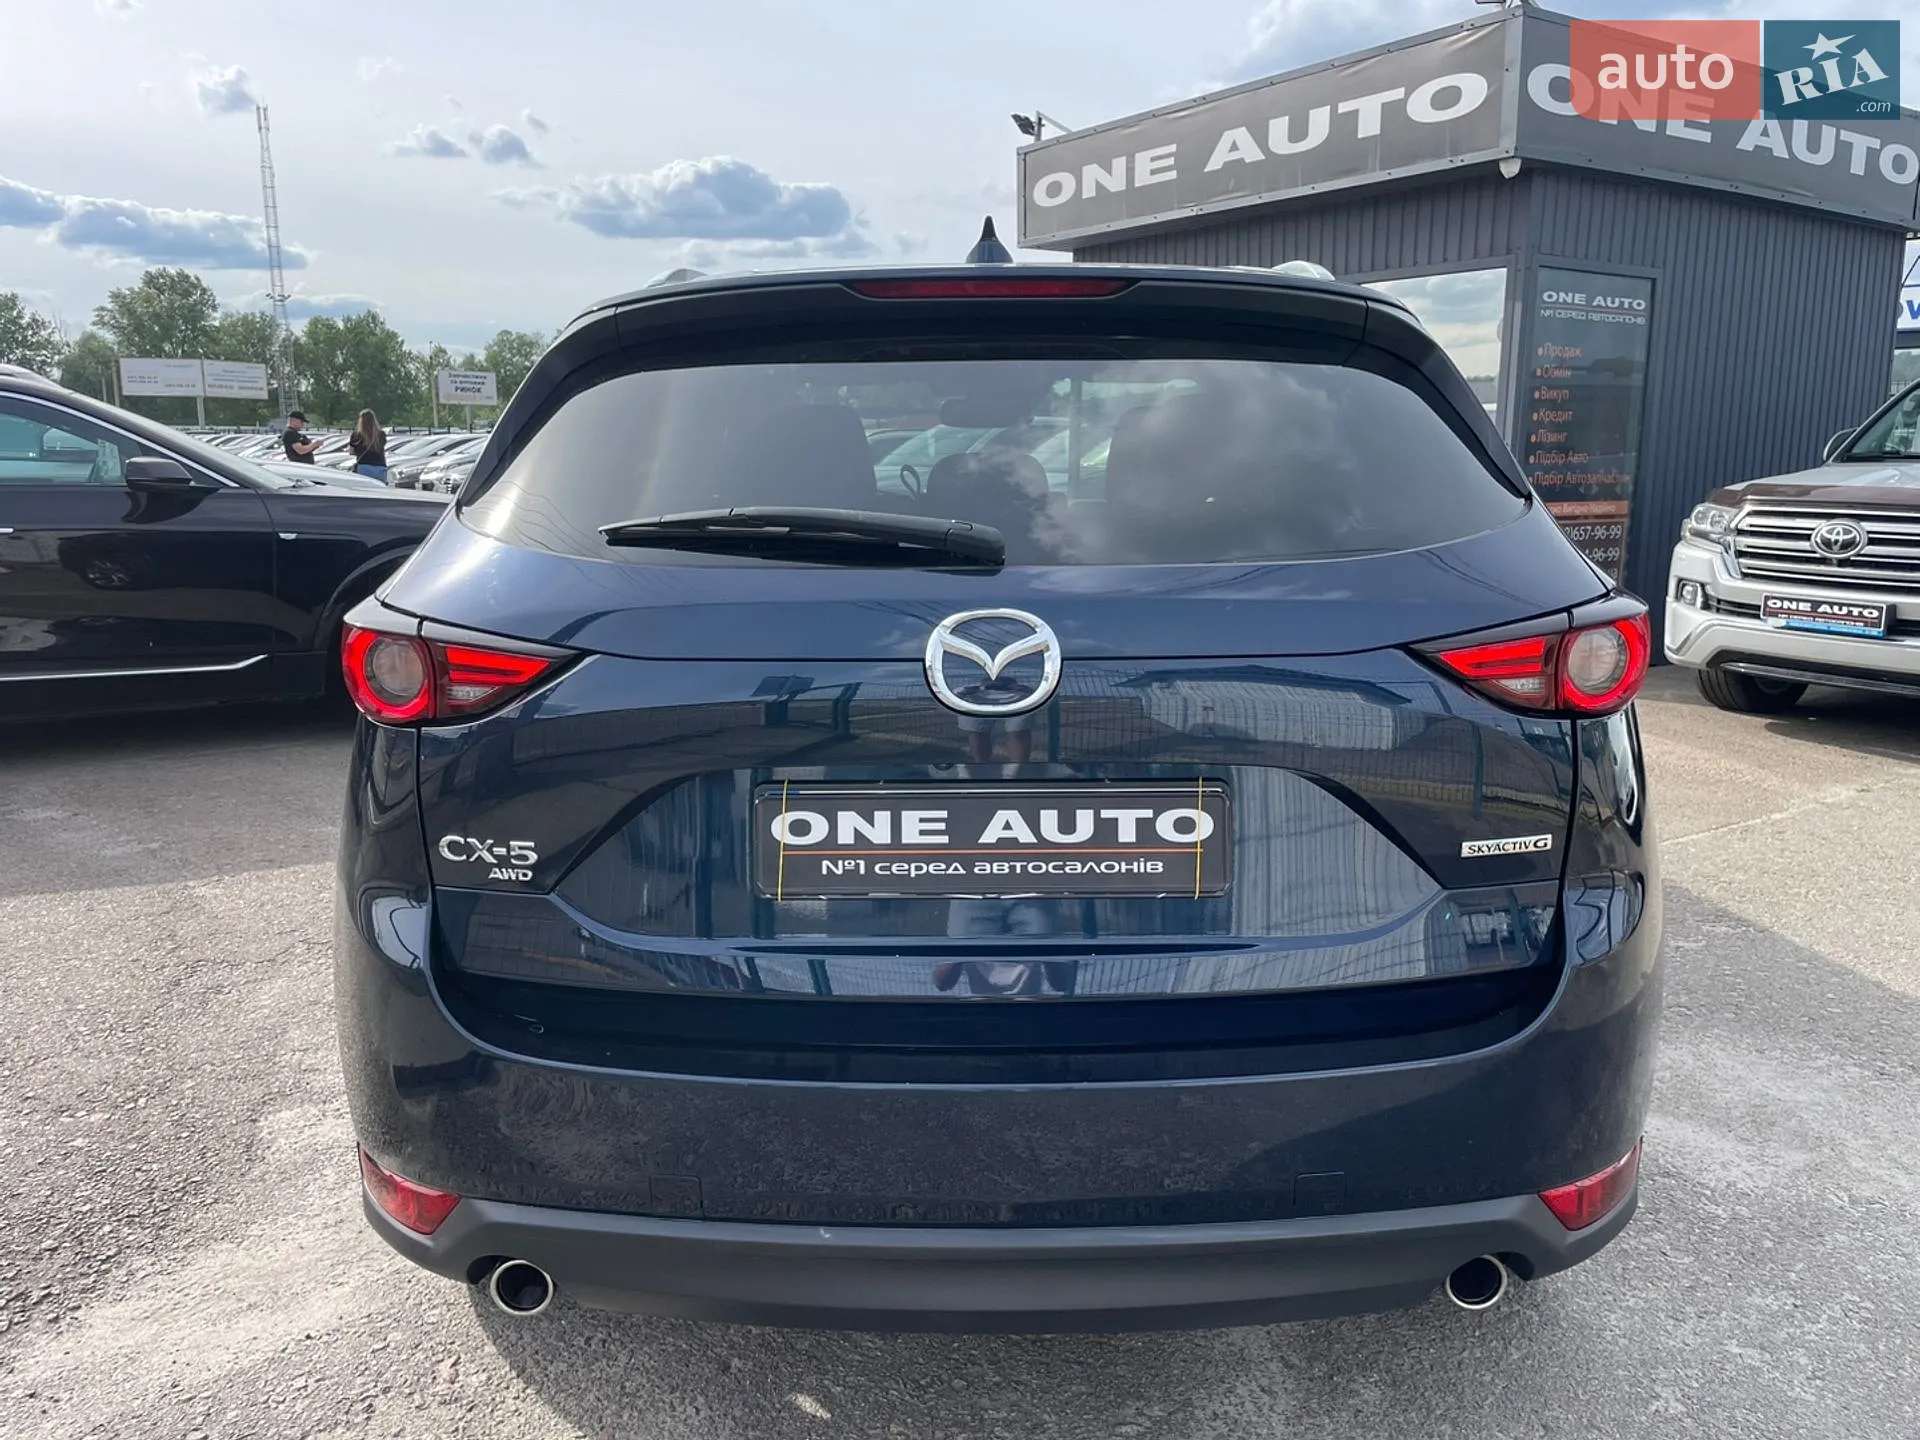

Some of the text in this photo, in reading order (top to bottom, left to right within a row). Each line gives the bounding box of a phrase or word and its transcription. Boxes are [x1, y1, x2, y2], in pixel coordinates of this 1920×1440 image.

[1526, 62, 1920, 186] ONE AUTO
[1032, 72, 1489, 208] ONE AUTO
[1542, 290, 1647, 310] ONE AUTO
[1543, 342, 1582, 360] Продаж
[1541, 385, 1570, 403] Викуп
[1538, 407, 1573, 425] Кредит
[1536, 429, 1568, 443] Лізинг
[1535, 450, 1565, 466] Підбір
[1533, 471, 1564, 487] Підбір
[1766, 599, 1880, 618] ONE AUTO
[770, 808, 1215, 845] ONE AUTO
[438, 835, 539, 866] CX-5
[487, 867, 534, 881] AWD
[821, 856, 1164, 879] №1 серед автосалонів
